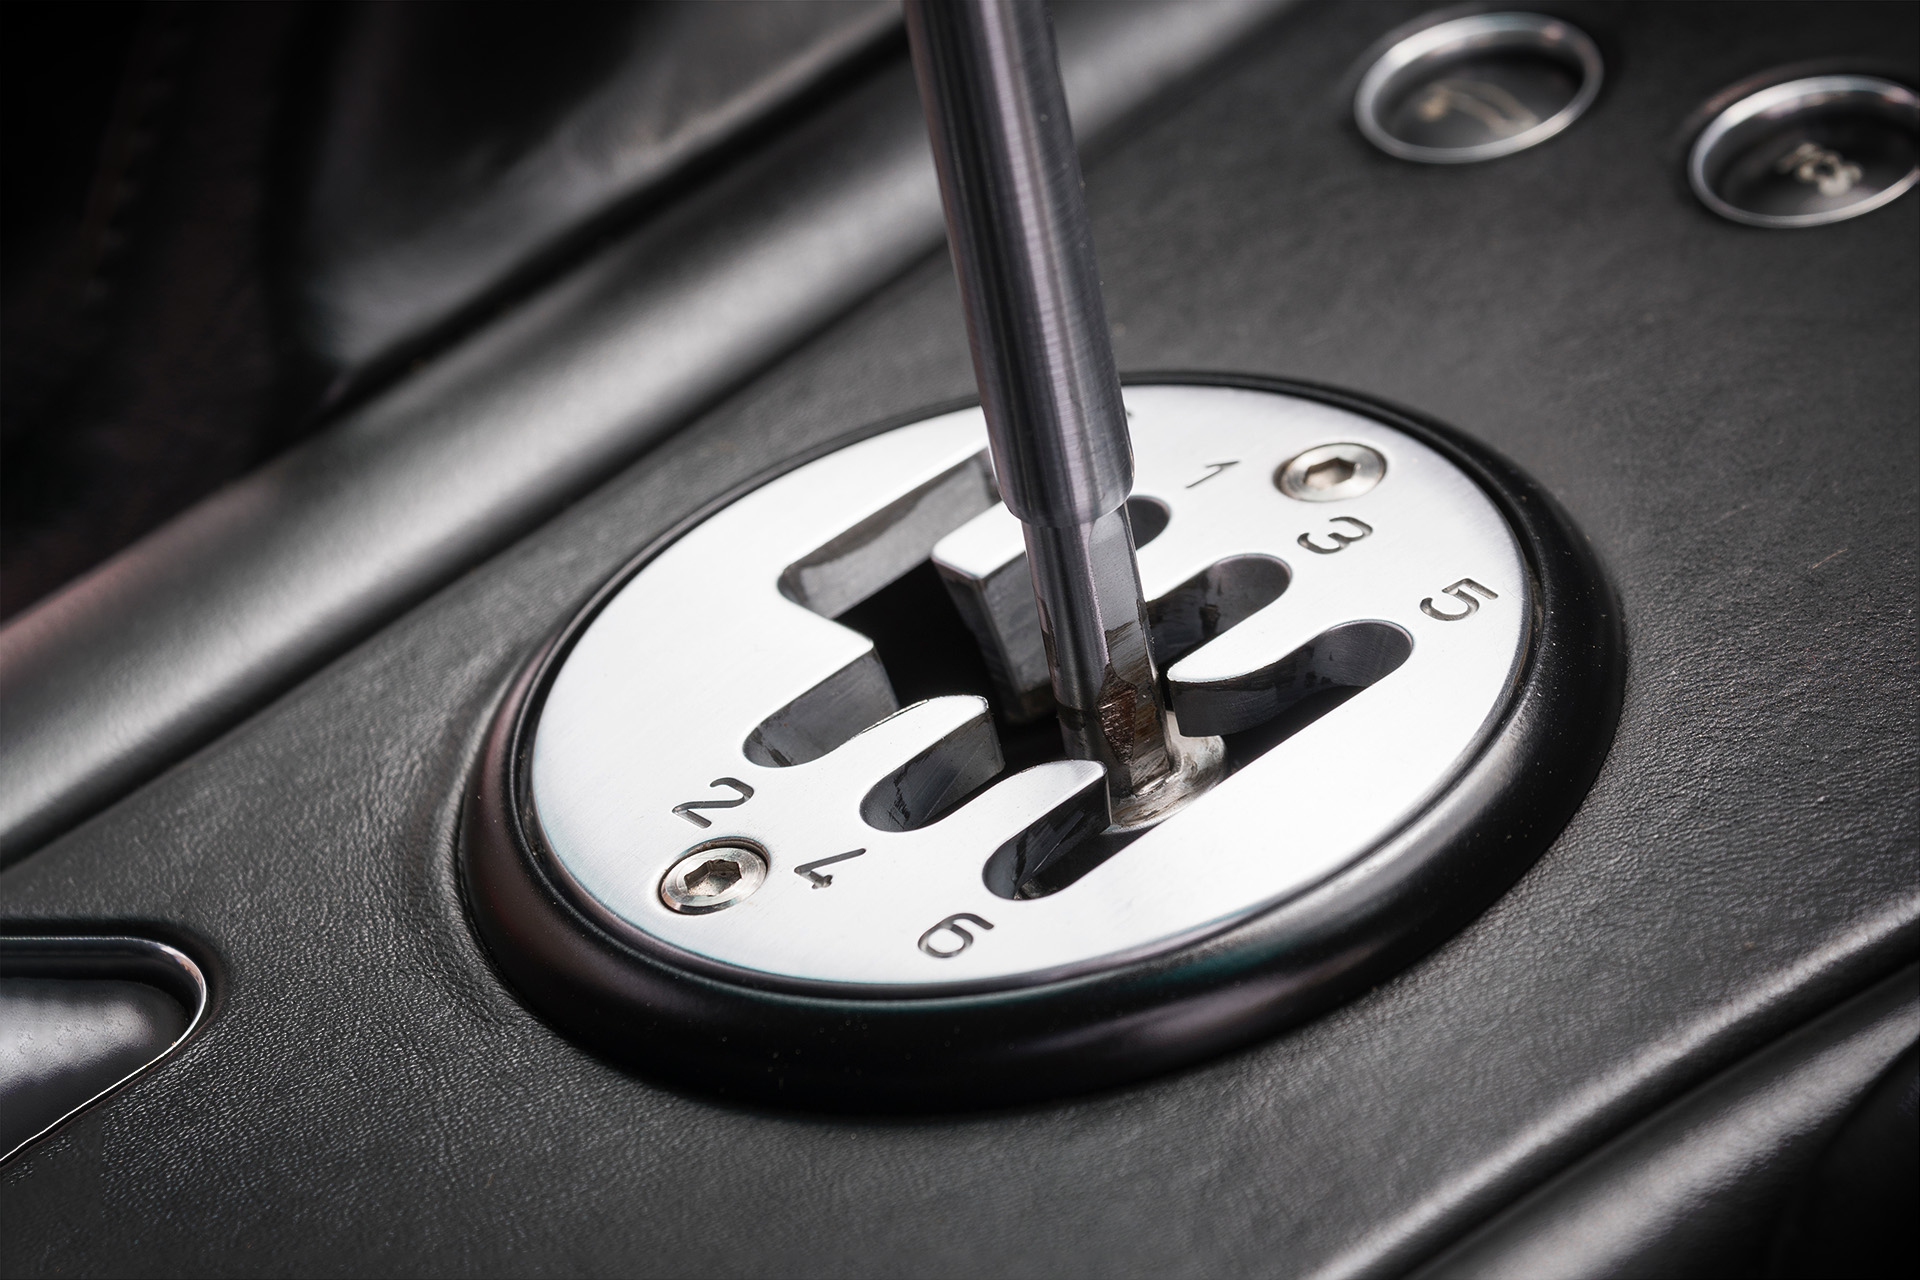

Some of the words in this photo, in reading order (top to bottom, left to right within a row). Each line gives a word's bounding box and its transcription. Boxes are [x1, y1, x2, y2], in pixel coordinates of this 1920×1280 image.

[1185, 460, 1240, 489] 1
[1297, 515, 1374, 555] 3
[1419, 577, 1499, 622] 5
[671, 776, 755, 829] 2
[917, 912, 995, 960] 6
